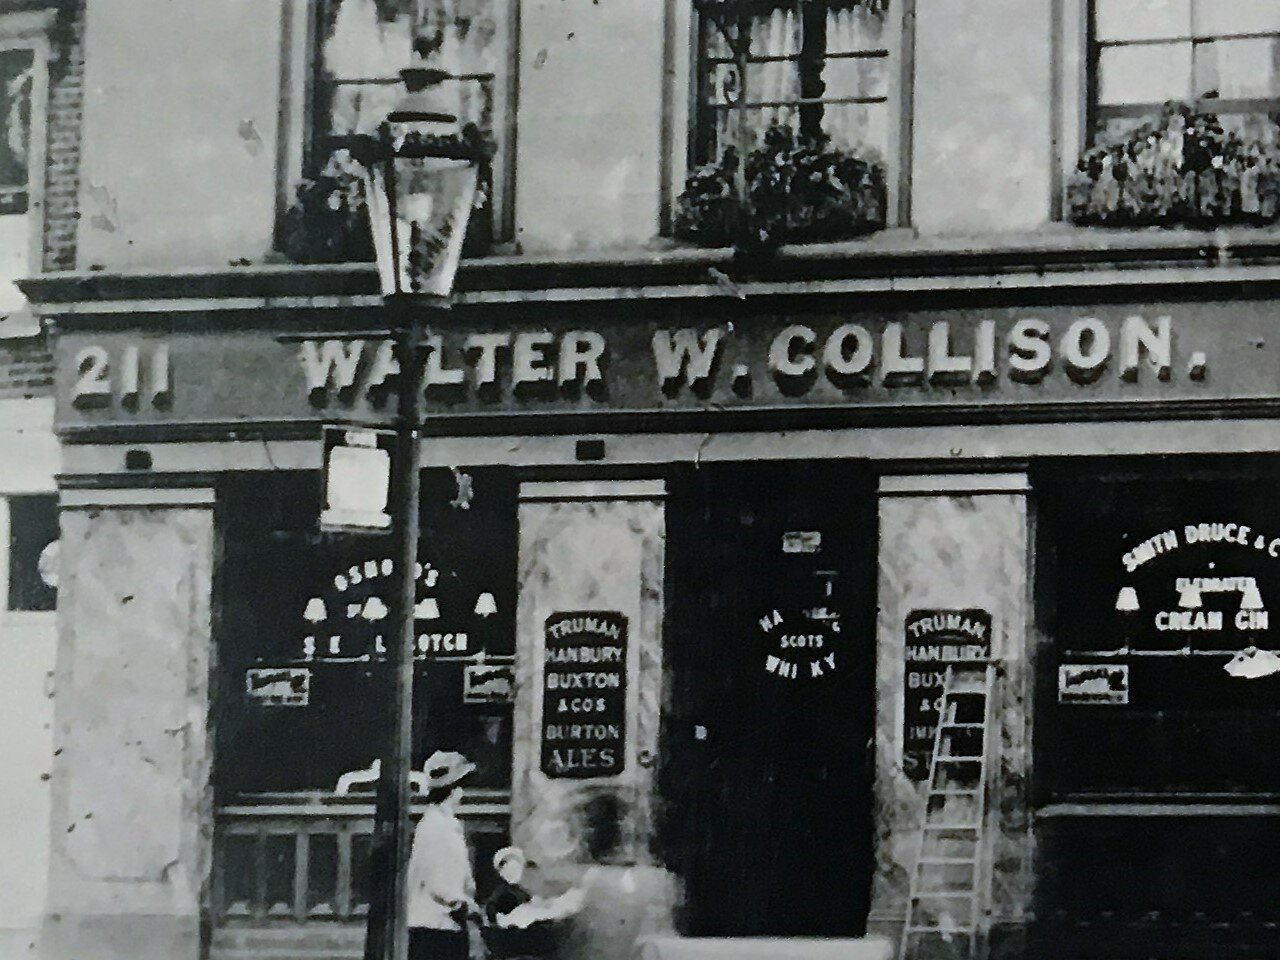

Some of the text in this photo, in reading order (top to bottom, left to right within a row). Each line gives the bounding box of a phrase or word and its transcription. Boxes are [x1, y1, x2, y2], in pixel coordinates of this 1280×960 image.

[72, 343, 172, 401] 211
[652, 324, 751, 385] W.
[768, 314, 1208, 380] COLLISON.
[907, 614, 987, 638] TRUMAN
[1235, 610, 1269, 631] GIN
[764, 652, 837, 680] WHIKY
[547, 672, 620, 689] BUXTON
[551, 748, 616, 770] ALES
